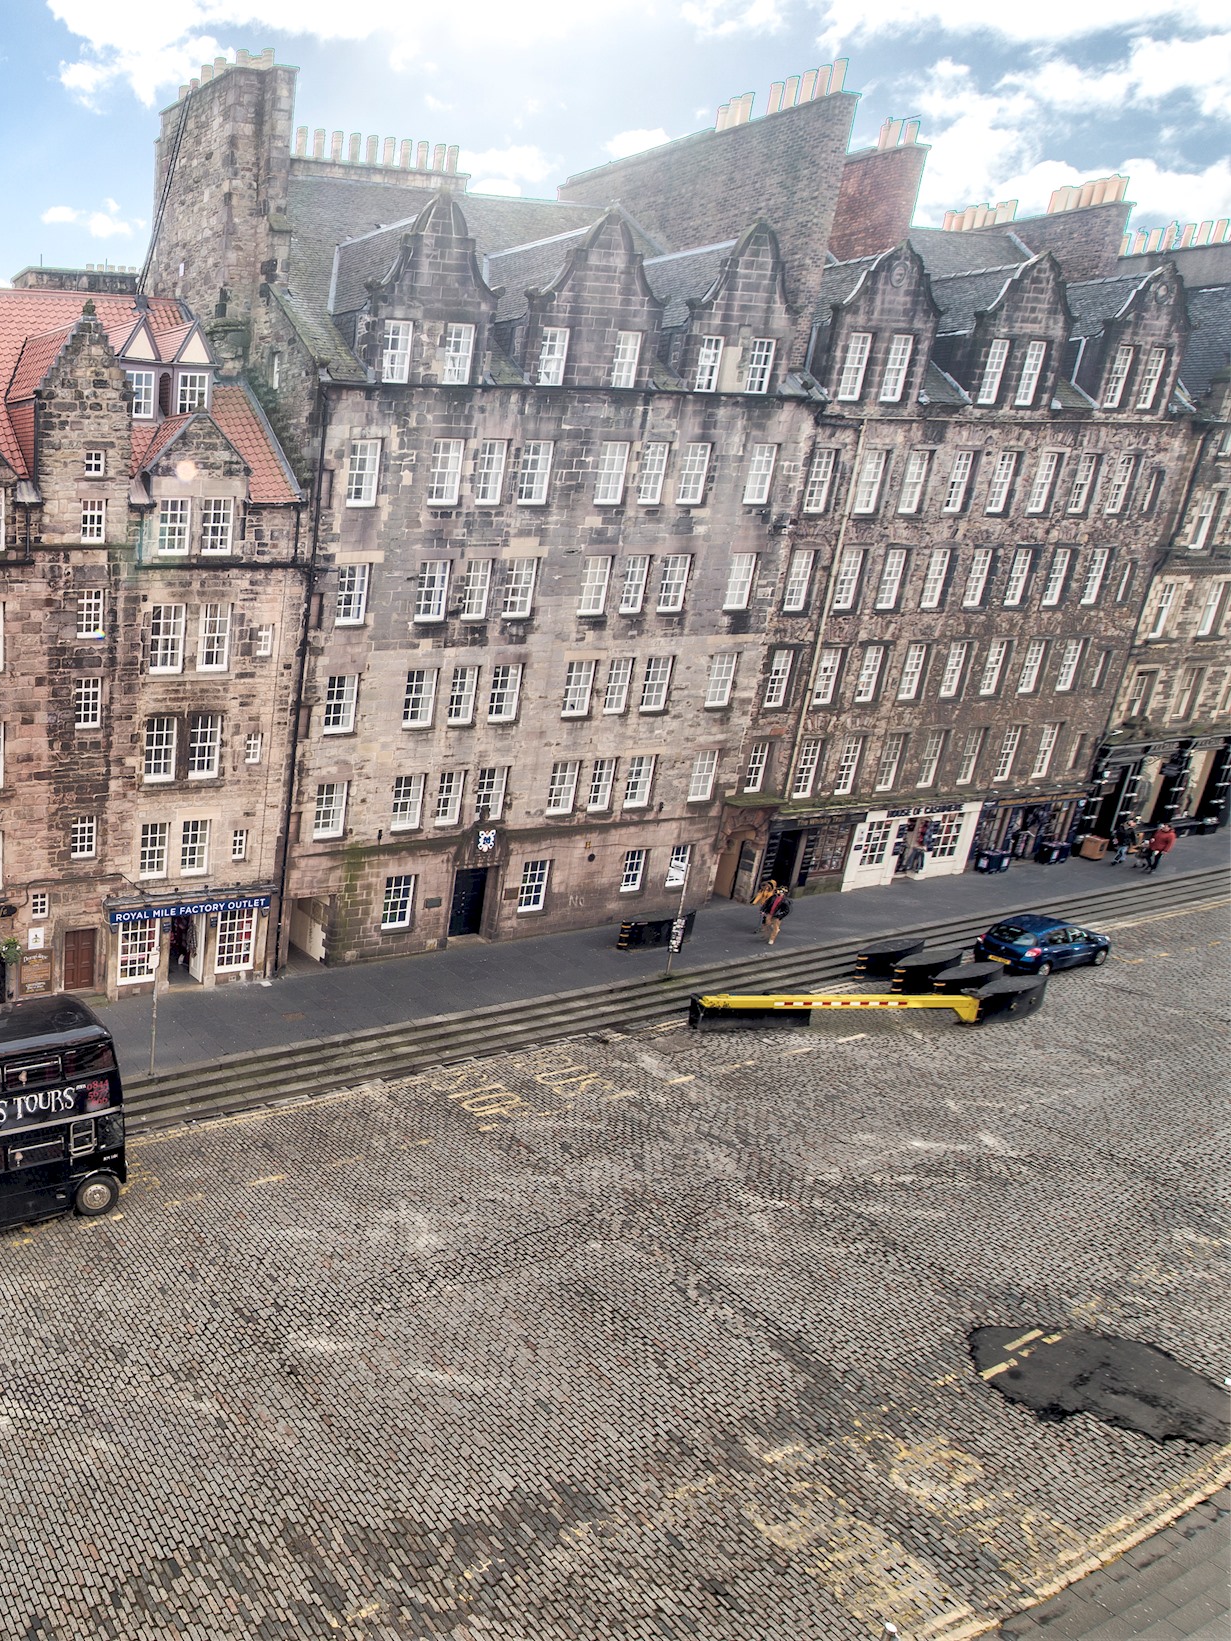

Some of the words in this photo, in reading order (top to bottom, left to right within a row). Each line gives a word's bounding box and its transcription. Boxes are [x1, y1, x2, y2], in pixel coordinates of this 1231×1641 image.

[887, 808, 912, 818] HOUSE
[913, 806, 923, 816] OF
[115, 911, 149, 922] ROYAL
[153, 907, 176, 918] MILE
[179, 902, 225, 914] FACTORY
[227, 898, 266, 910] OUTLET
[13, 1086, 77, 1120] TOURS
